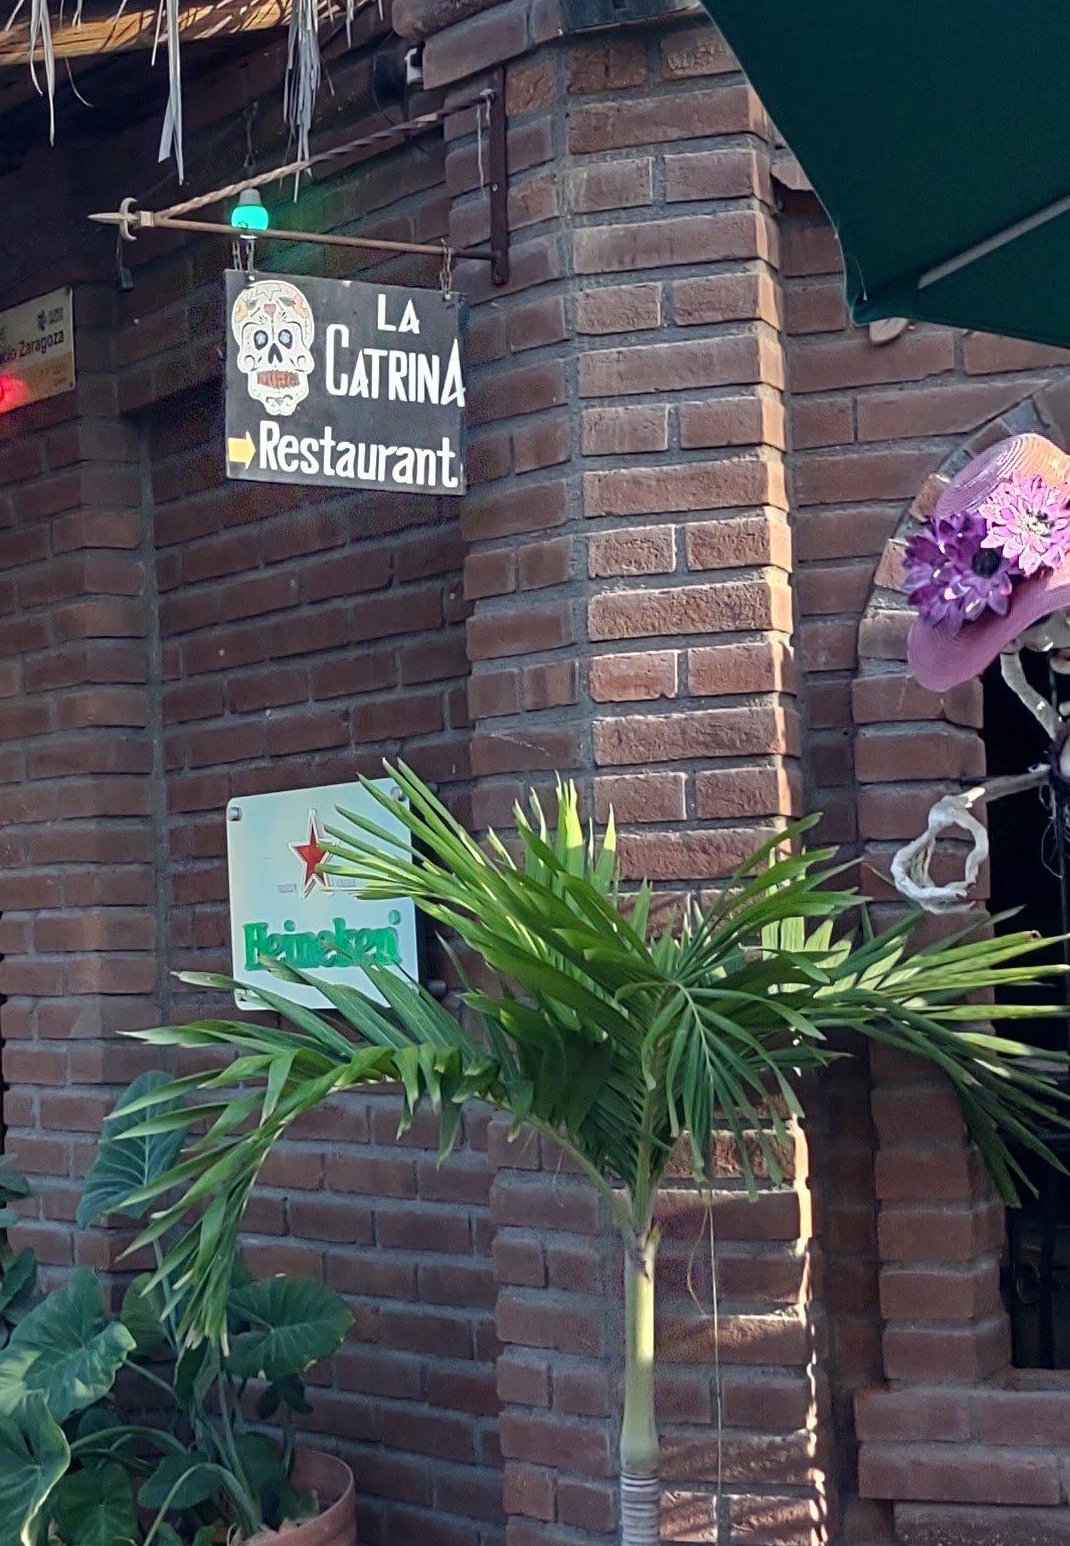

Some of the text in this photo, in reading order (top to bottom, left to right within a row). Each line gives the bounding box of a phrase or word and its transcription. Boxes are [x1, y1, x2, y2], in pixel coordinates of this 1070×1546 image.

[377, 293, 420, 334] LA
[18, 330, 65, 358] Zaragoza
[325, 323, 465, 408] CATRINA
[259, 420, 459, 489] Restaurant
